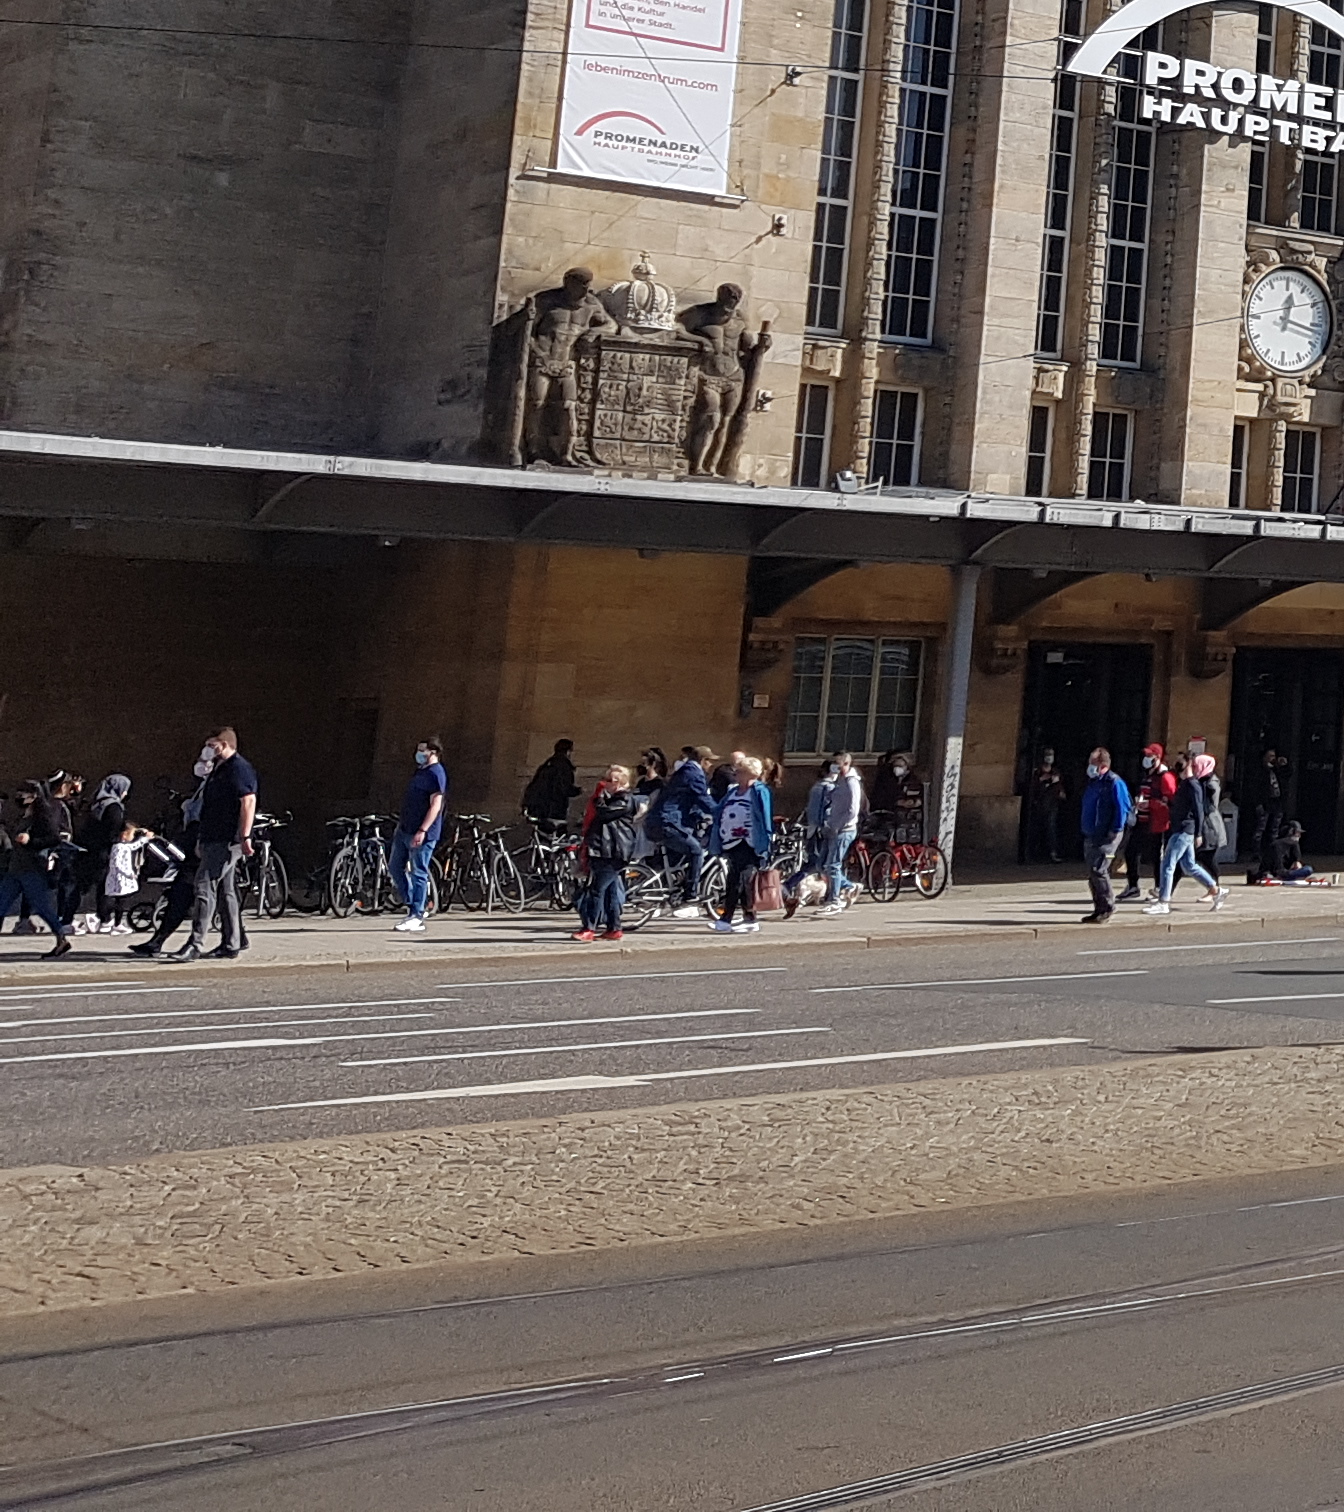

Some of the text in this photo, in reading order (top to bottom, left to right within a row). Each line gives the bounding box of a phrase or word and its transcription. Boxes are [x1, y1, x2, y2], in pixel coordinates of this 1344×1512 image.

[599, 0, 666, 17] und die Kultur
[674, 1, 706, 14] Handel
[609, 13, 646, 24] unserer
[583, 59, 719, 92] lebenimzentrum.com
[593, 130, 701, 154] PROMENADEN
[593, 141, 698, 161] HAUPTBAHNHOF
